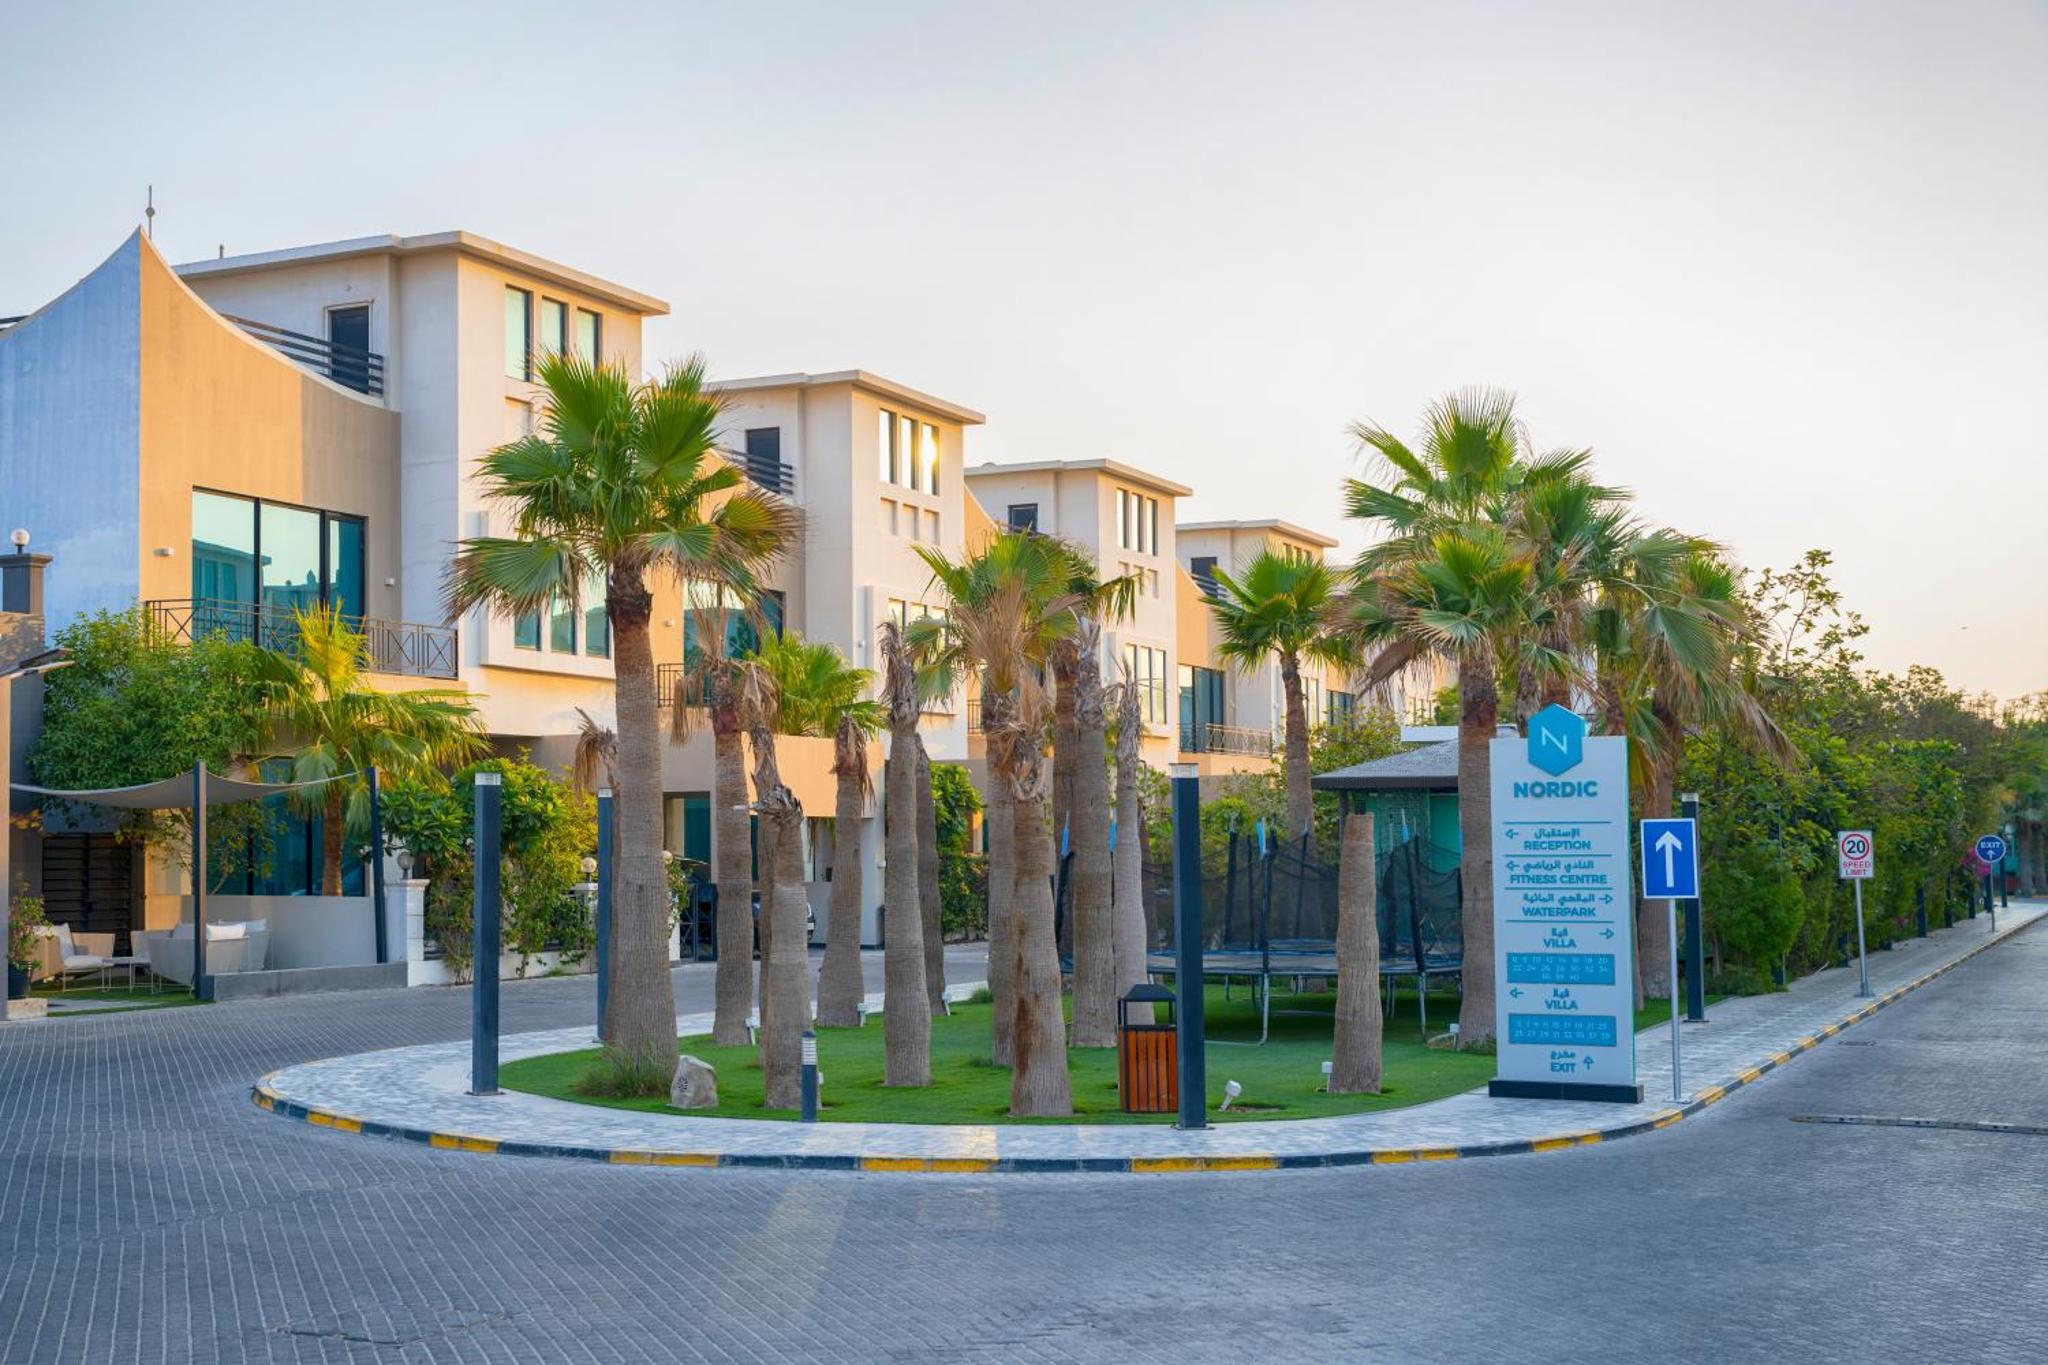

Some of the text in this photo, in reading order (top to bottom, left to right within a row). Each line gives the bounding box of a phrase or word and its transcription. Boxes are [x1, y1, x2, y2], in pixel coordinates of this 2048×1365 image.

[1541, 726, 1567, 755] N
[1513, 781, 1598, 798] NORDIC
[1523, 840, 1592, 850] RECEPTION
[1847, 840, 1866, 854] 20
[1980, 841, 2001, 849] EXIT
[1843, 861, 1871, 869] SPEED
[1510, 874, 1607, 884] FITNESS CENTRE
[1523, 907, 1596, 917] WATERPARK
[1543, 938, 1577, 948] VILLA
[1545, 999, 1579, 1010] VILLA
[1550, 1062, 1576, 1073] EXIT
